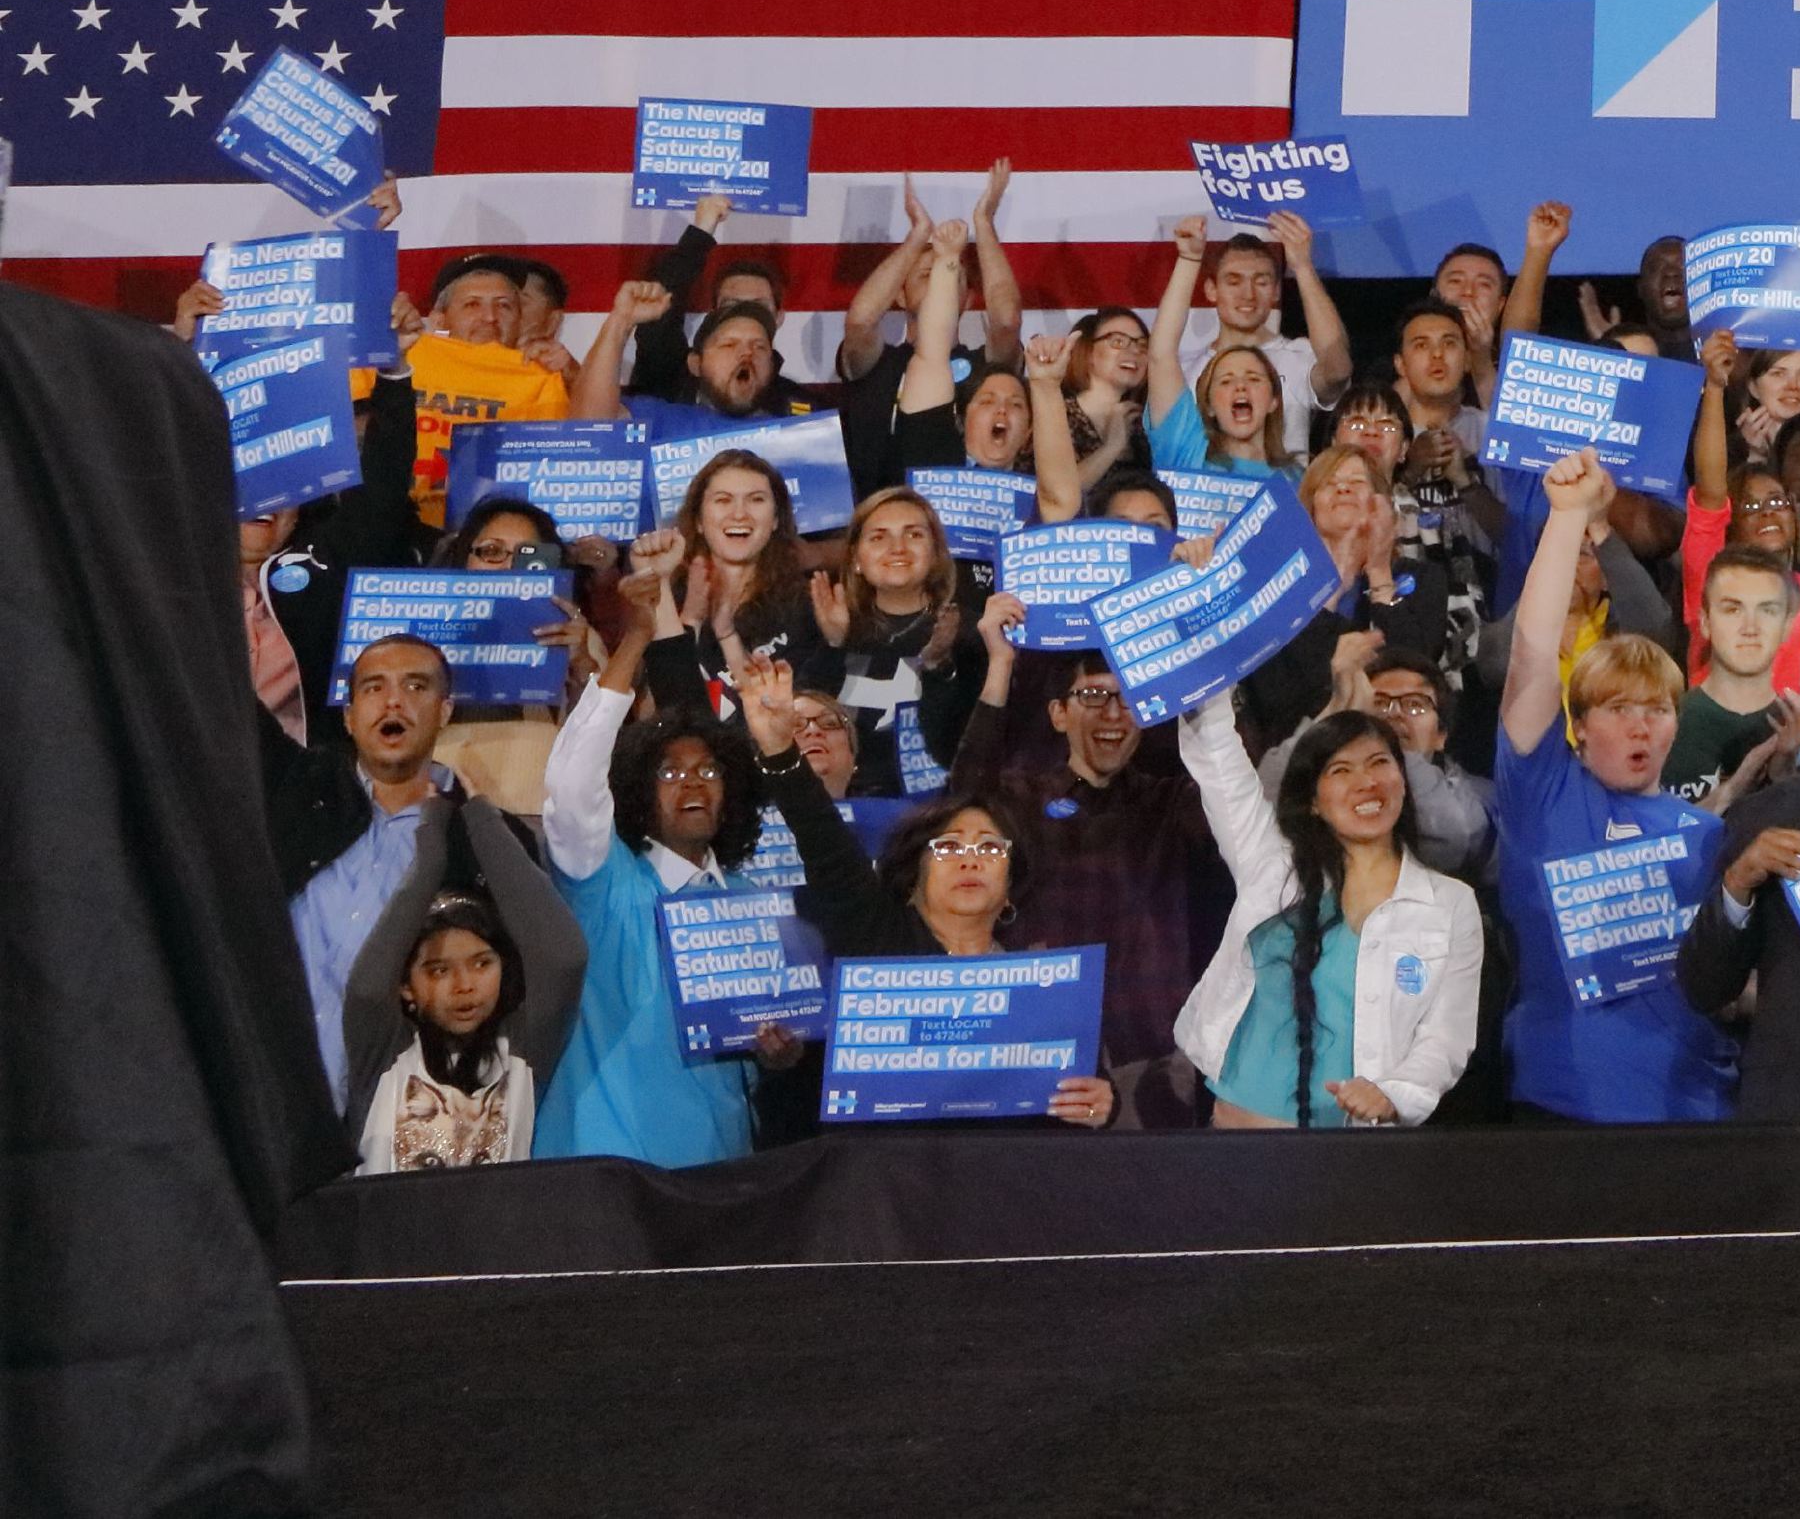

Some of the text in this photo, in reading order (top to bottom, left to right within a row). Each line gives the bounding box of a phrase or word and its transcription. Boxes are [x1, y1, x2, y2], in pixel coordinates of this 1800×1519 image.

[266, 71, 349, 136] Caucus is
[280, 53, 376, 135] The Nevada
[251, 84, 338, 153] Saturday,
[644, 103, 765, 125] The Nevada
[239, 101, 324, 165] February
[321, 156, 358, 185] 20!
[643, 121, 742, 140] Caucus is
[641, 138, 740, 161] Saturday,
[1192, 141, 1350, 179] Fighting
[640, 156, 769, 179] February 20!
[1201, 169, 1306, 202] for us
[256, 237, 343, 264] Nevada
[1687, 248, 1772, 280] February 20
[294, 264, 314, 281] is
[223, 285, 314, 310] aturday,
[1731, 290, 1758, 304] for
[202, 304, 354, 333] February 20!
[226, 341, 321, 375] conmigo!
[1512, 338, 1647, 381] The Nevada
[1506, 361, 1617, 397] Caucus is
[238, 384, 264, 410] 20
[1500, 381, 1611, 421] Saturday,
[1496, 403, 1641, 445] February 20!
[236, 424, 329, 468] for Hillary
[652, 444, 692, 462] The
[497, 458, 643, 481] February 20!
[912, 470, 1037, 494] The Nevada
[530, 482, 640, 500] Saturday,
[913, 483, 1013, 503] Caucus is
[1157, 471, 1262, 498] The Nevad
[554, 502, 639, 519] Caucus
[930, 498, 1014, 519] aturday,
[1228, 497, 1244, 512] is
[603, 522, 636, 540] The
[939, 511, 1009, 534] bruary
[1002, 533, 1050, 553] The
[1056, 526, 1156, 544] Nevada
[1003, 543, 1129, 569] Caucus is
[356, 577, 554, 601] ¡Caucus conmigo!
[1003, 564, 1130, 588] Saturday,
[1093, 569, 1192, 620] ¡Caucus
[1104, 558, 1243, 643] February 20
[352, 599, 490, 621] February 20
[1125, 557, 1307, 686] Nevada for Hillary
[350, 621, 405, 637] 11am
[441, 623, 477, 632] LOCATE
[1116, 627, 1177, 662] 11am
[1204, 586, 1241, 613] LOCATE
[474, 646, 544, 667] Hillary
[1543, 837, 1687, 884] The Nevada
[1553, 866, 1667, 907] Caucus is
[664, 893, 796, 926] The Nevada
[1559, 892, 1676, 932] Saturday,
[672, 919, 779, 951] Caucus is
[1563, 918, 1673, 958] February
[676, 946, 784, 978] Saturday,
[844, 957, 1078, 988] ¡Caucus conmigo!
[680, 964, 822, 1005] February 20!
[841, 993, 966, 1018] February
[972, 992, 1005, 1013] 20
[841, 1019, 991, 1042] 11am Text LOCATE
[920, 1032, 932, 1041] to
[837, 1045, 1073, 1070] Nevada for Hillary
